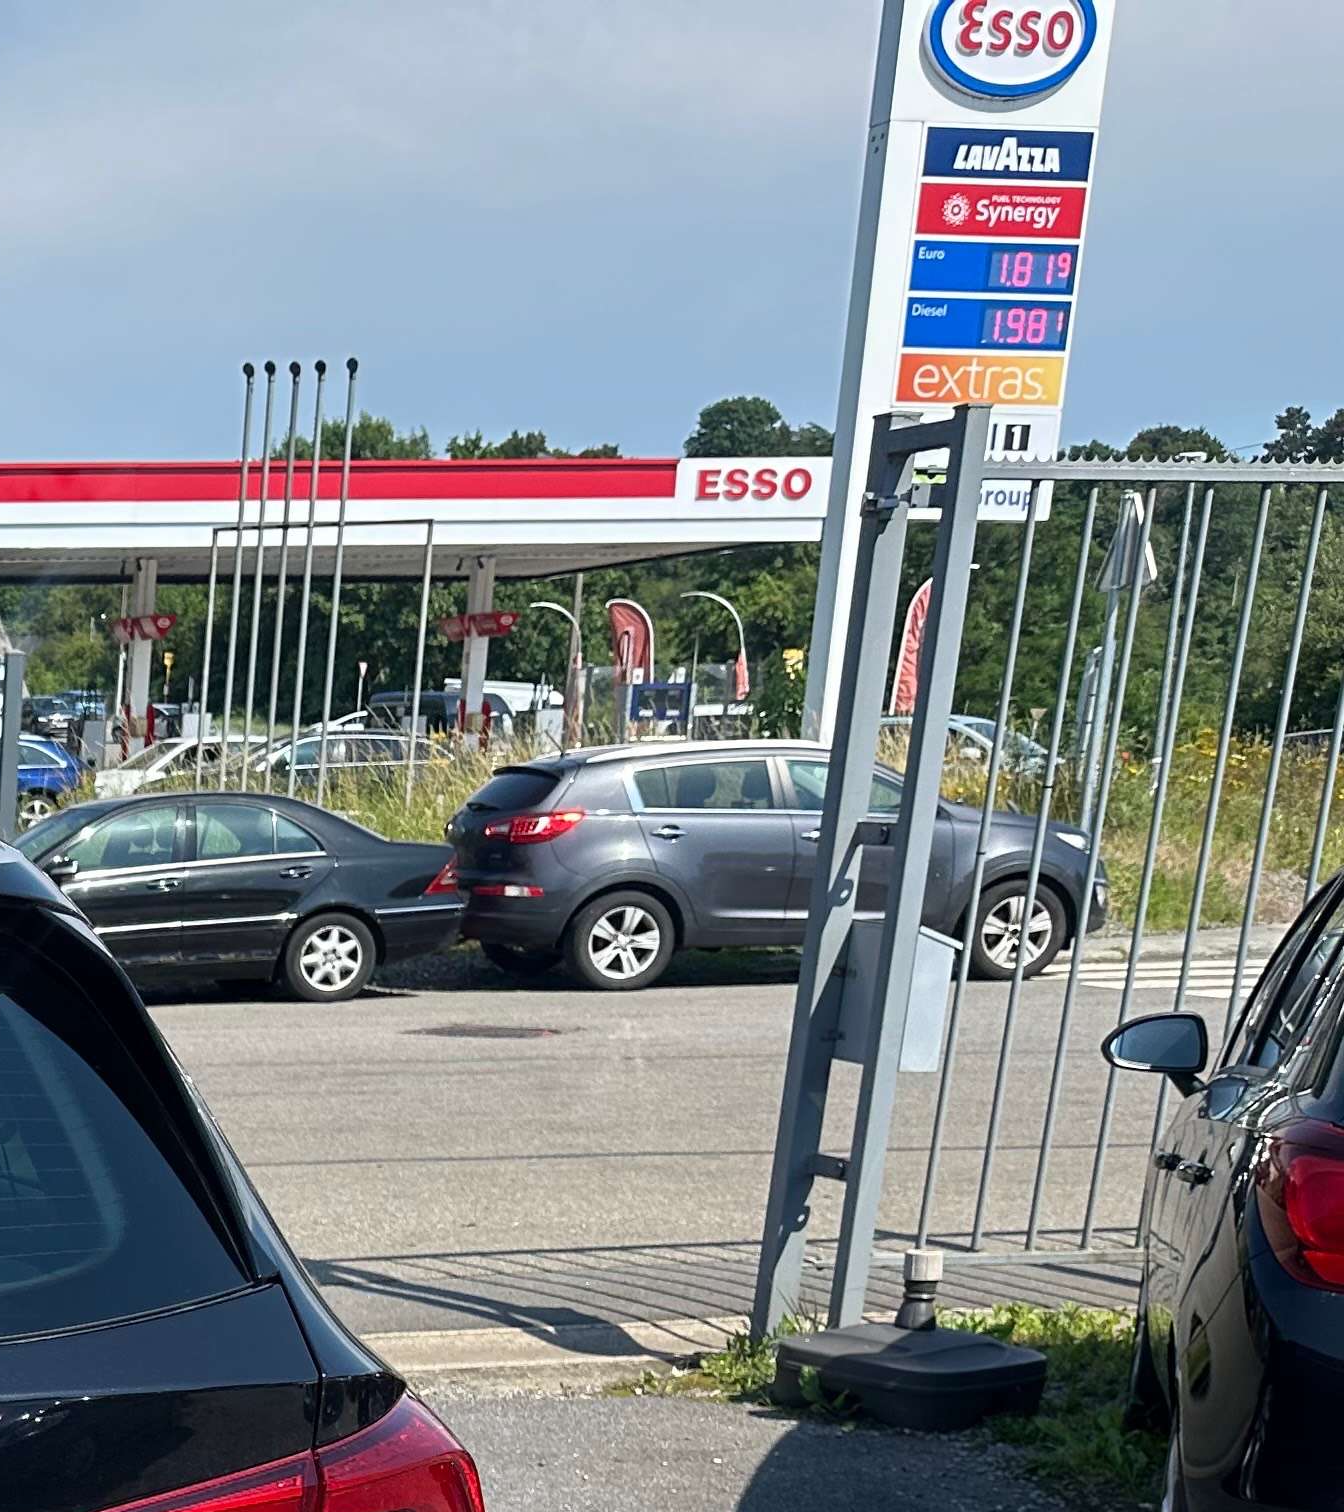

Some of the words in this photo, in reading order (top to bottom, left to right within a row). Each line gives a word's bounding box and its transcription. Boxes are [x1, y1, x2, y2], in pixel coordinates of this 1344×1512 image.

[953, 137, 1060, 173] LAVAZZA
[992, 195, 1010, 203] FUEL
[1012, 195, 1062, 204] TECHNOLOGY
[975, 199, 1061, 229] Synergy
[918, 247, 945, 259] Euro
[912, 304, 948, 317] Diesel
[695, 468, 812, 501] ESSO
